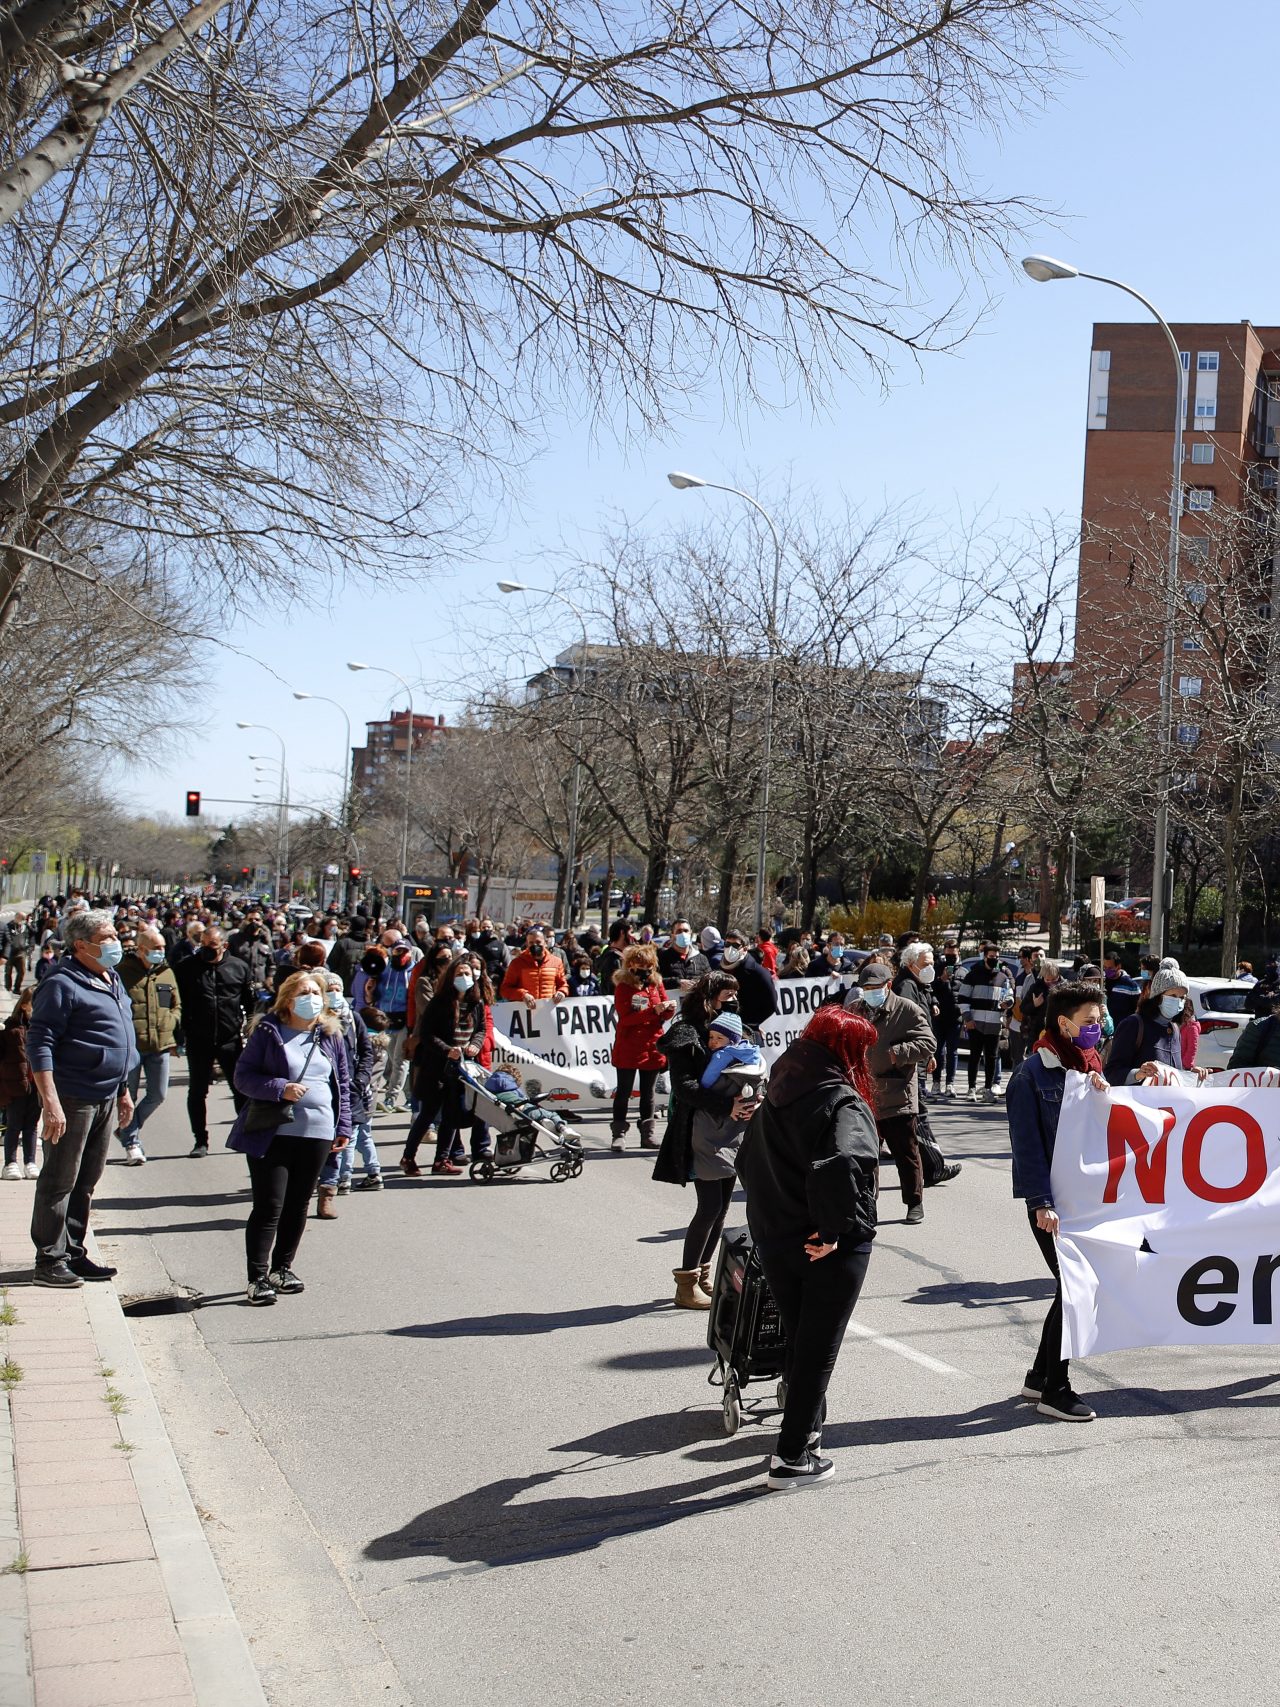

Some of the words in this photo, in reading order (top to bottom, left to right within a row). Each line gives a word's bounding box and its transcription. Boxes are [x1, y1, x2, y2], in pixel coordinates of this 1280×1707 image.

[509, 1009, 541, 1039] AL
[575, 1045, 588, 1067] la
[1103, 1104, 1268, 1205] NO
